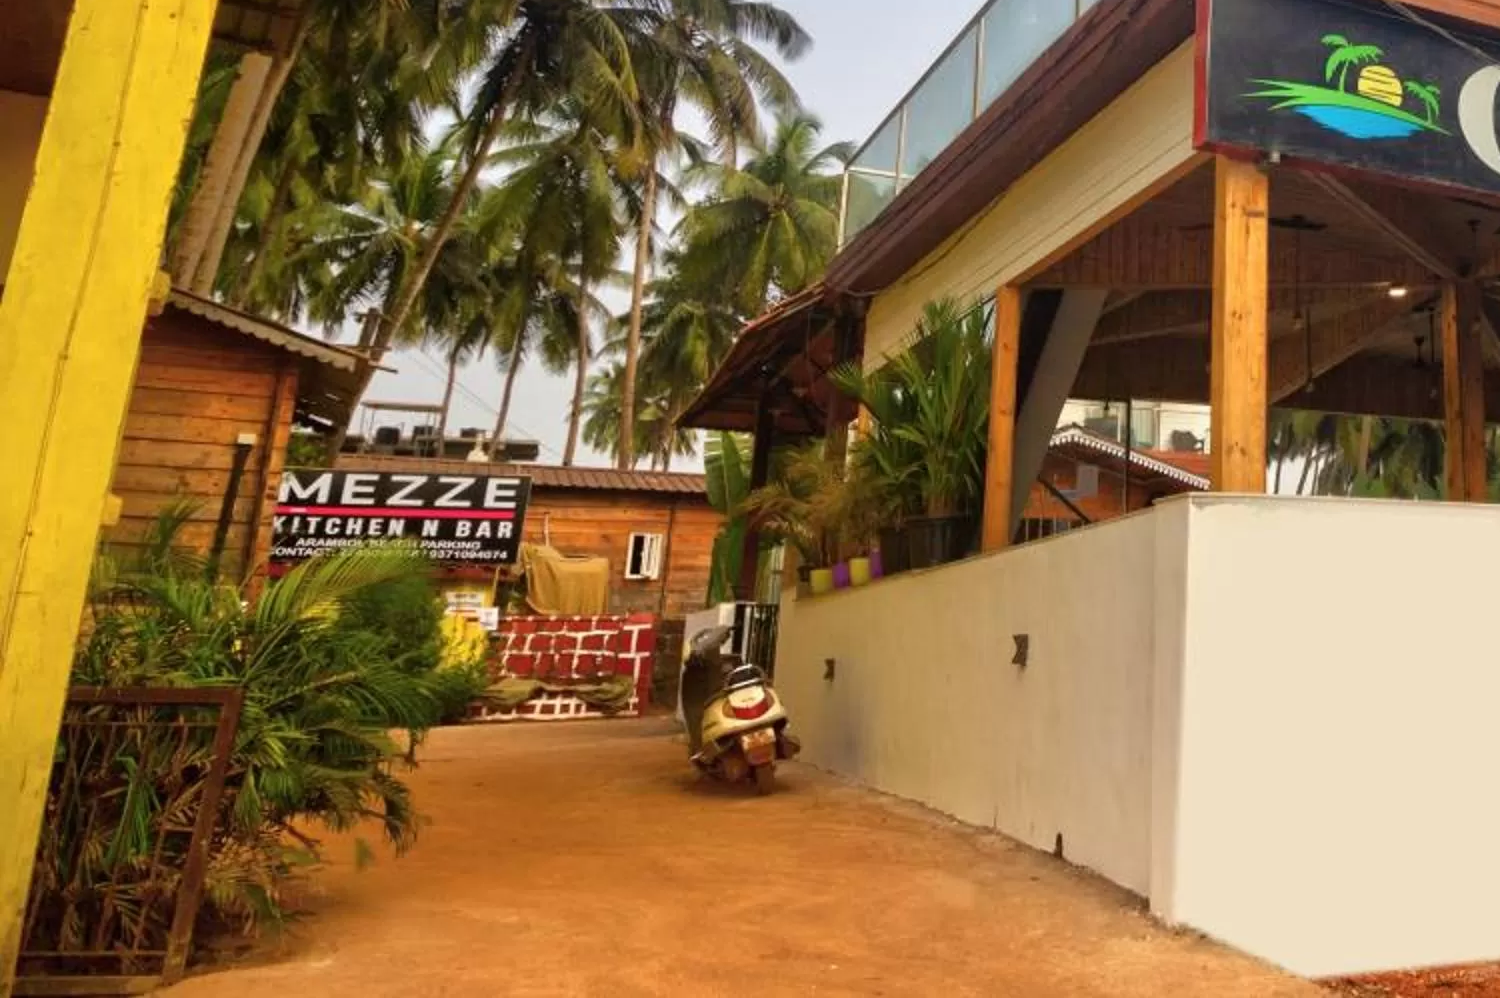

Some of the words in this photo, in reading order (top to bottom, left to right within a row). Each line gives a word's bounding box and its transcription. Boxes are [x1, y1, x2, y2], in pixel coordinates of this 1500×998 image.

[277, 472, 521, 508] MEZZE
[273, 516, 406, 536] KITCHEN
[421, 519, 440, 536] N
[455, 520, 514, 539] BAR
[419, 541, 481, 551] PARKING
